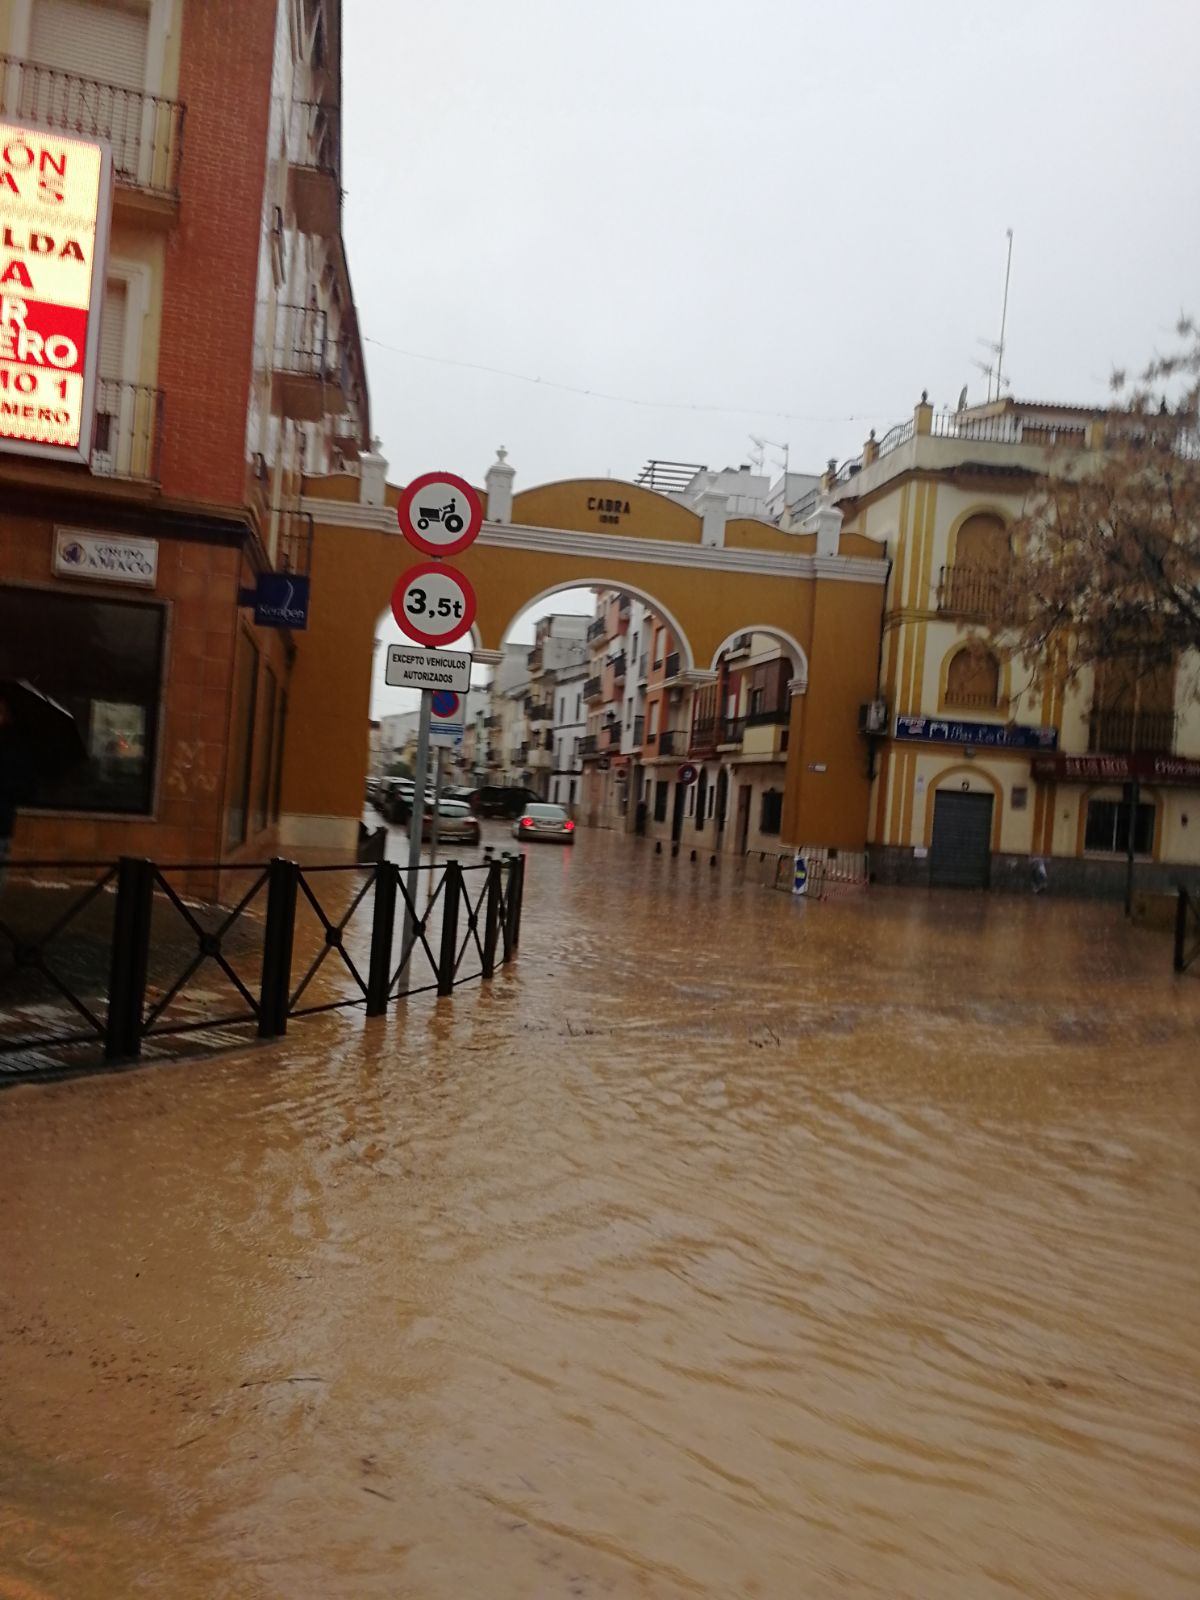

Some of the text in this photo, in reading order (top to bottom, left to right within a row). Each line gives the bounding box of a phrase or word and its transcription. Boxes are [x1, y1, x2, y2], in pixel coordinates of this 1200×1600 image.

[406, 588, 463, 618] 3,5t
[392, 653, 425, 666] EXCEPTO
[403, 670, 453, 684] AUTORIZADOS
